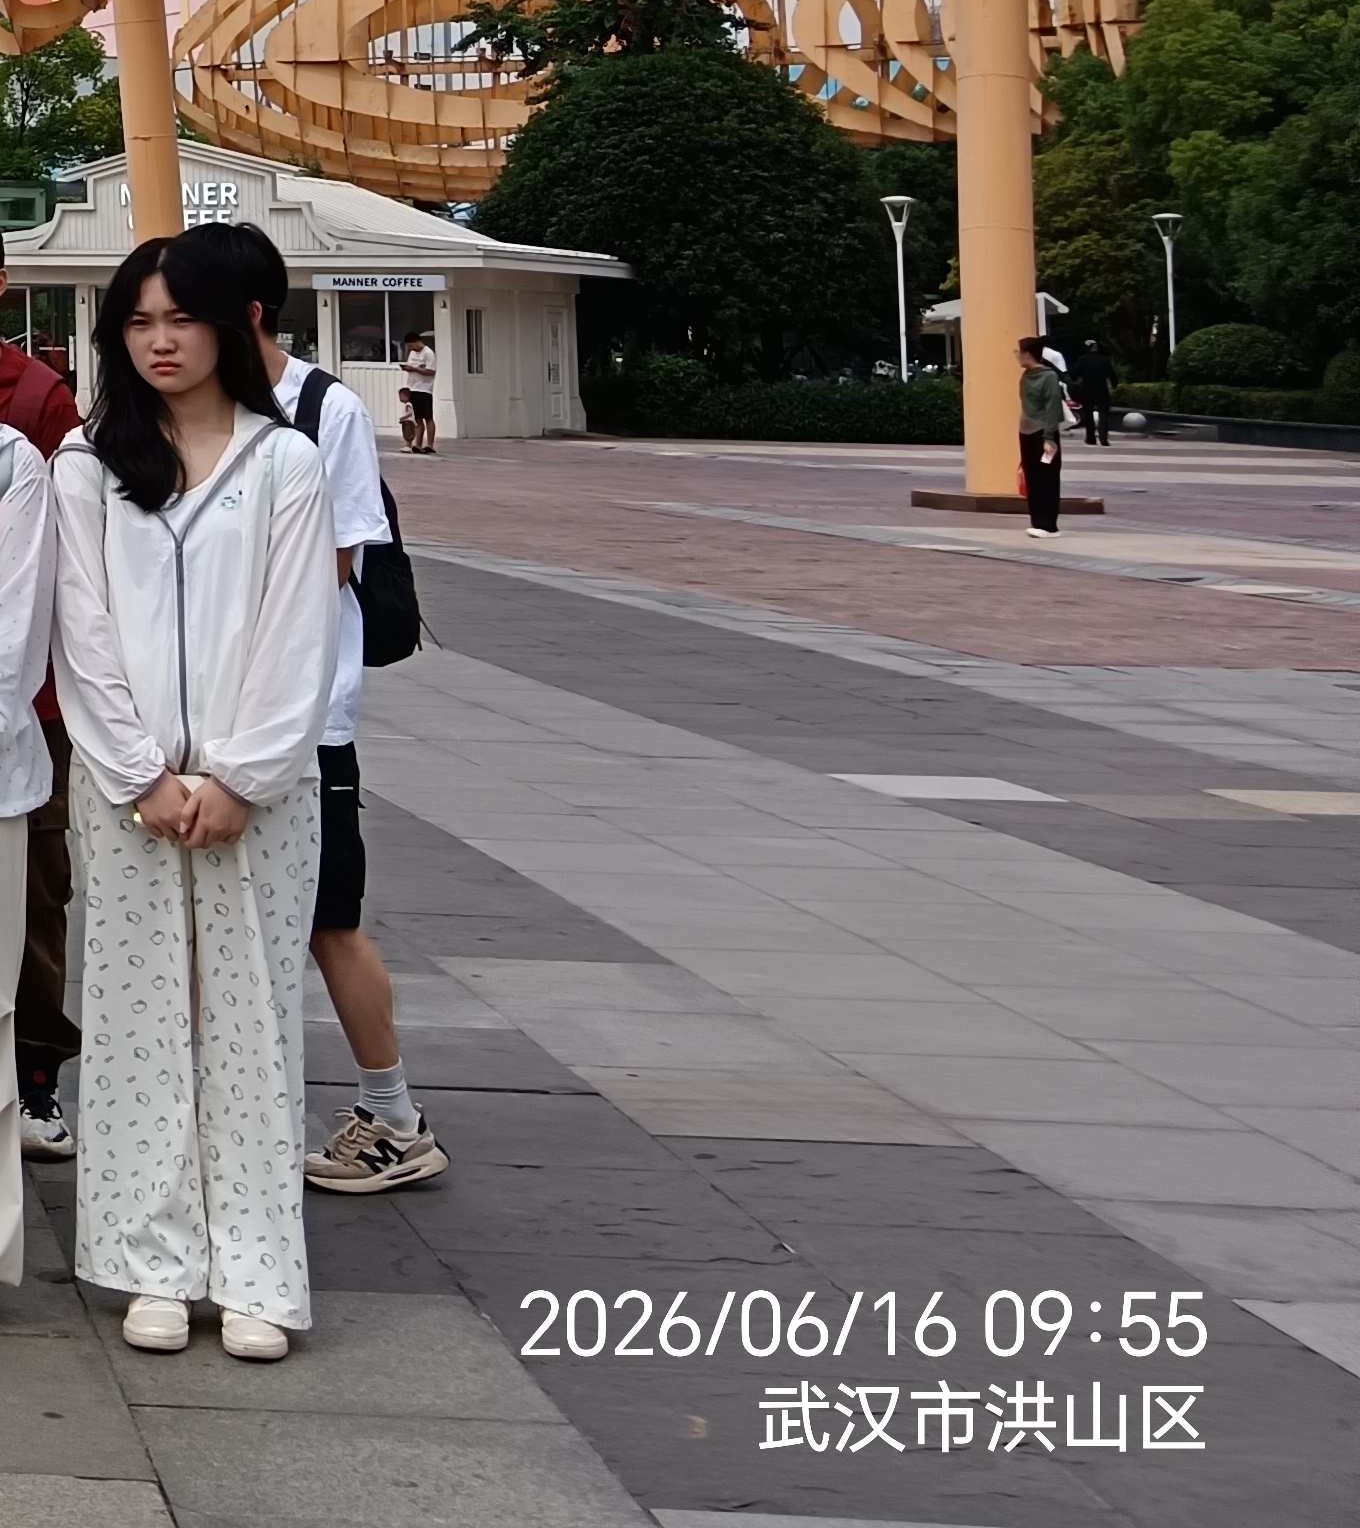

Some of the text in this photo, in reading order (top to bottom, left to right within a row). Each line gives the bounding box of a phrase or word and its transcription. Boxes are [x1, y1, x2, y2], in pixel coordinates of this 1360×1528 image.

[120, 183, 237, 206] MNER
[332, 277, 423, 288] MANNER COFFEE
